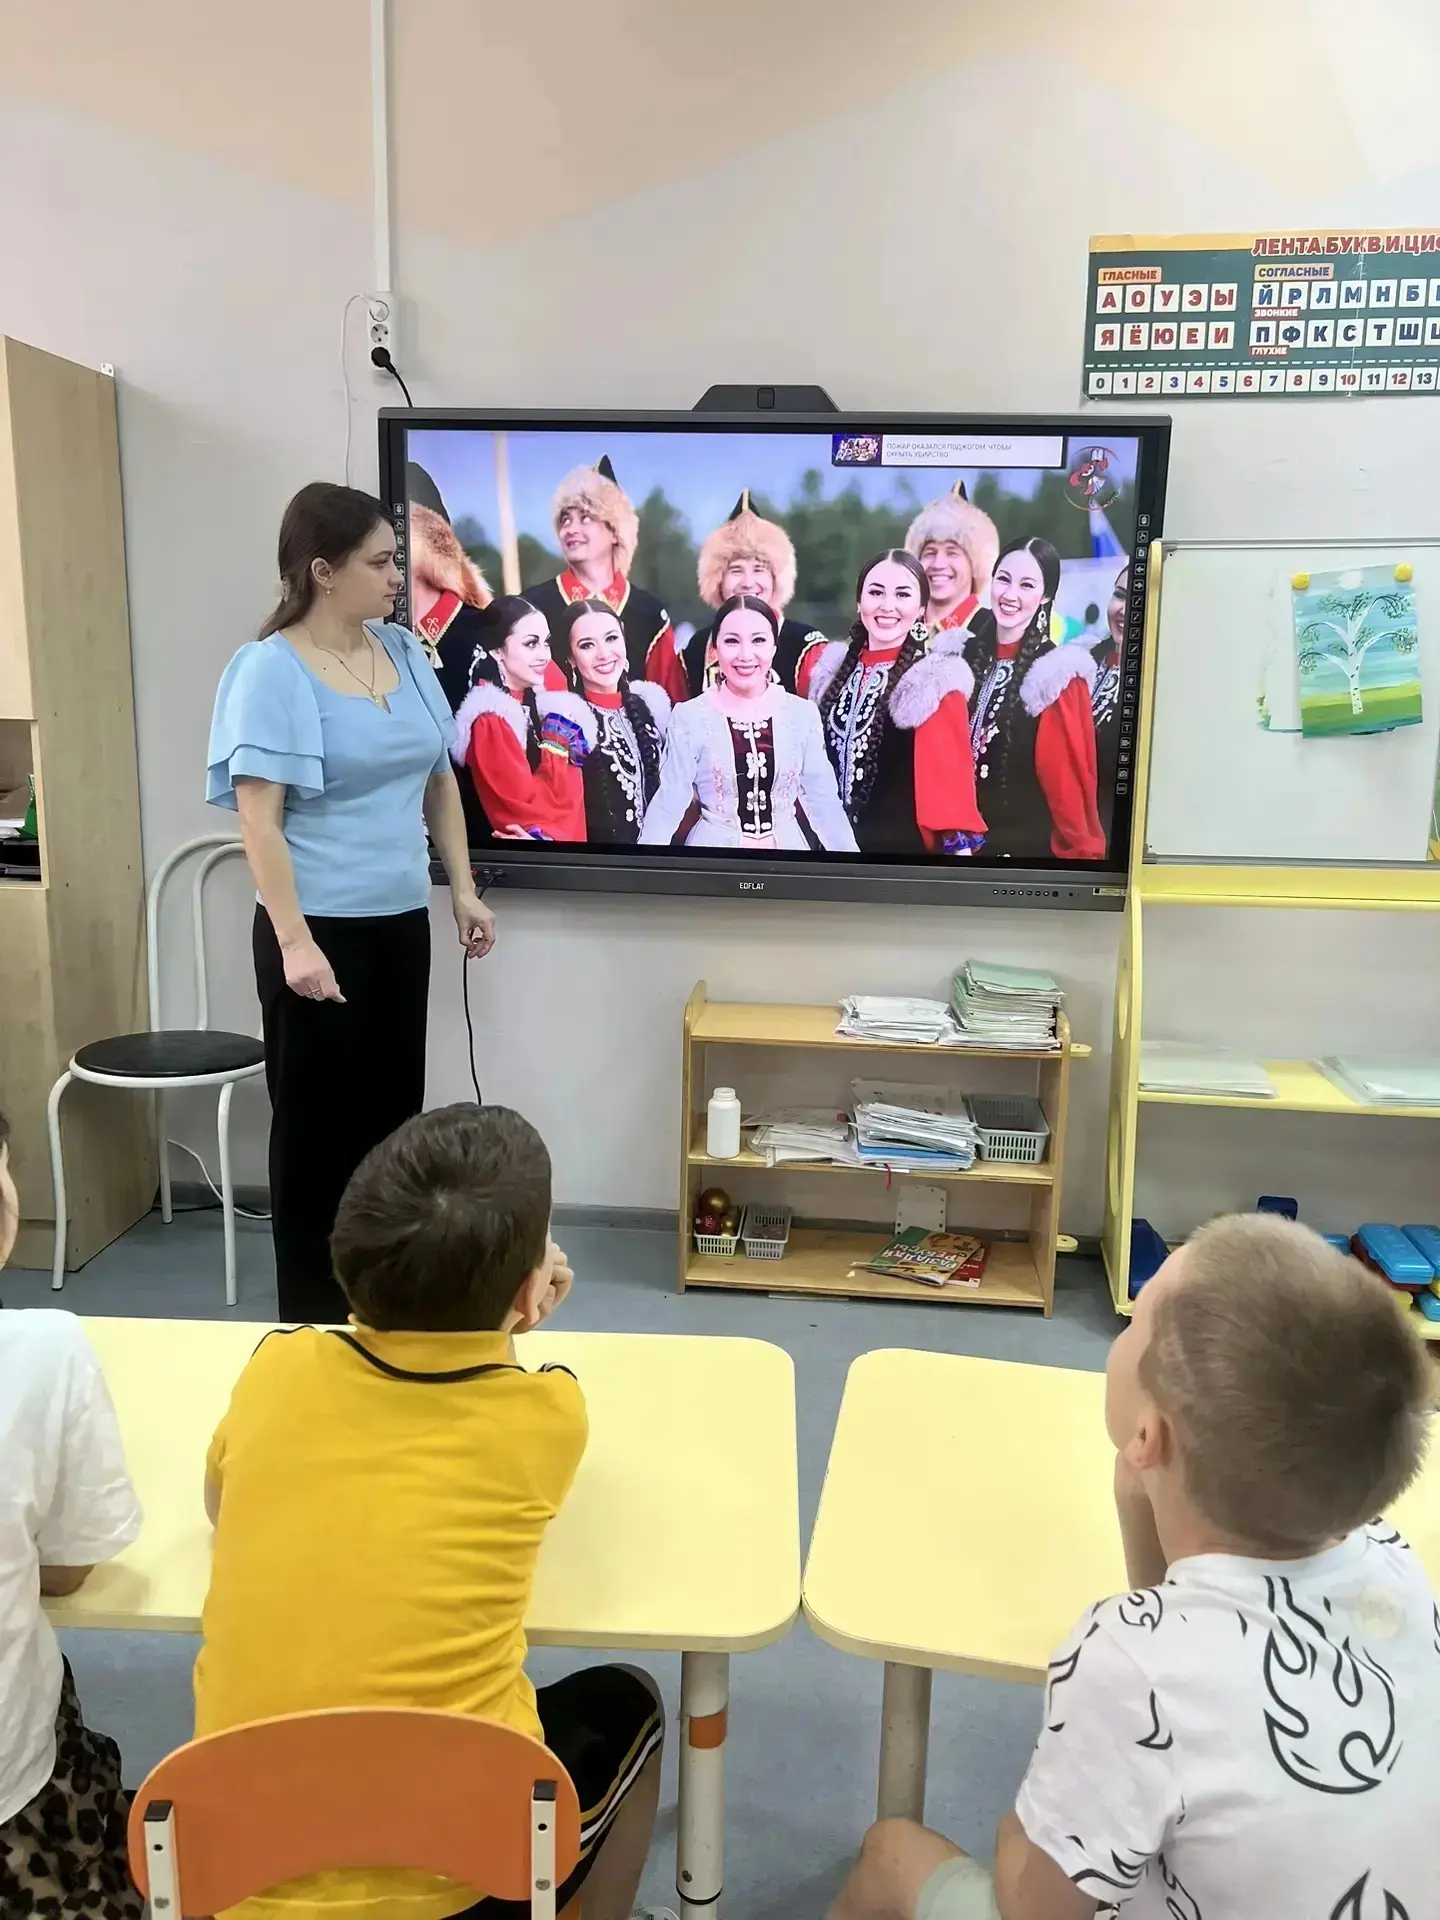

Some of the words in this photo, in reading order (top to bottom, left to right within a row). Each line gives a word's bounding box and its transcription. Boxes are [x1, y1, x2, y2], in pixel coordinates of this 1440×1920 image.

[1251, 236, 1322, 256] ЛЕНТА
[1326, 235, 1381, 254] БУКВ
[1386, 235, 1401, 253] И
[1103, 270, 1157, 281] ГЛАСНЫЕ
[1259, 267, 1329, 277] СОГЛАСНЫЕ
[1102, 292, 1116, 308] А
[1131, 290, 1145, 307] О
[1161, 290, 1173, 306] У
[1188, 290, 1202, 306] Э
[1214, 289, 1234, 306] Ы
[1258, 284, 1273, 305] Й
[1288, 288, 1302, 304] Р
[1316, 288, 1331, 304] Л
[1344, 286, 1362, 303] М
[1376, 285, 1391, 302] Н
[1406, 285, 1420, 301] Б
[1254, 308, 1298, 317] ЗВОНКИЕ
[1100, 329, 1114, 346] Я
[1129, 324, 1142, 345] Ё
[1154, 328, 1174, 345] Ю
[1187, 328, 1199, 344] Е
[1214, 327, 1229, 344] И
[1256, 327, 1270, 342] П
[1282, 326, 1300, 343] Ф
[1314, 326, 1328, 342] К
[1343, 325, 1357, 342] С
[1373, 324, 1387, 340] Т
[1399, 324, 1419, 340] Ш
[1251, 347, 1288, 355] ГЛУХИЕ
[1096, 377, 1105, 389] 0
[1122, 377, 1128, 389] 1
[1145, 377, 1155, 388] 2
[1170, 377, 1179, 388] 3
[1194, 376, 1204, 387] 4
[1219, 376, 1228, 387] 5
[1243, 376, 1253, 387] 6
[1269, 375, 1278, 387] 7
[1293, 375, 1303, 386] 8
[1319, 374, 1328, 386] 9
[1340, 374, 1357, 386] 10
[1367, 373, 1381, 385] 11
[1392, 373, 1408, 385] 12
[1417, 373, 1432, 384] 13
[882, 1249, 957, 1269] РАЗГАДАЙ
[893, 1243, 958, 1261] РЕБУСЫ
